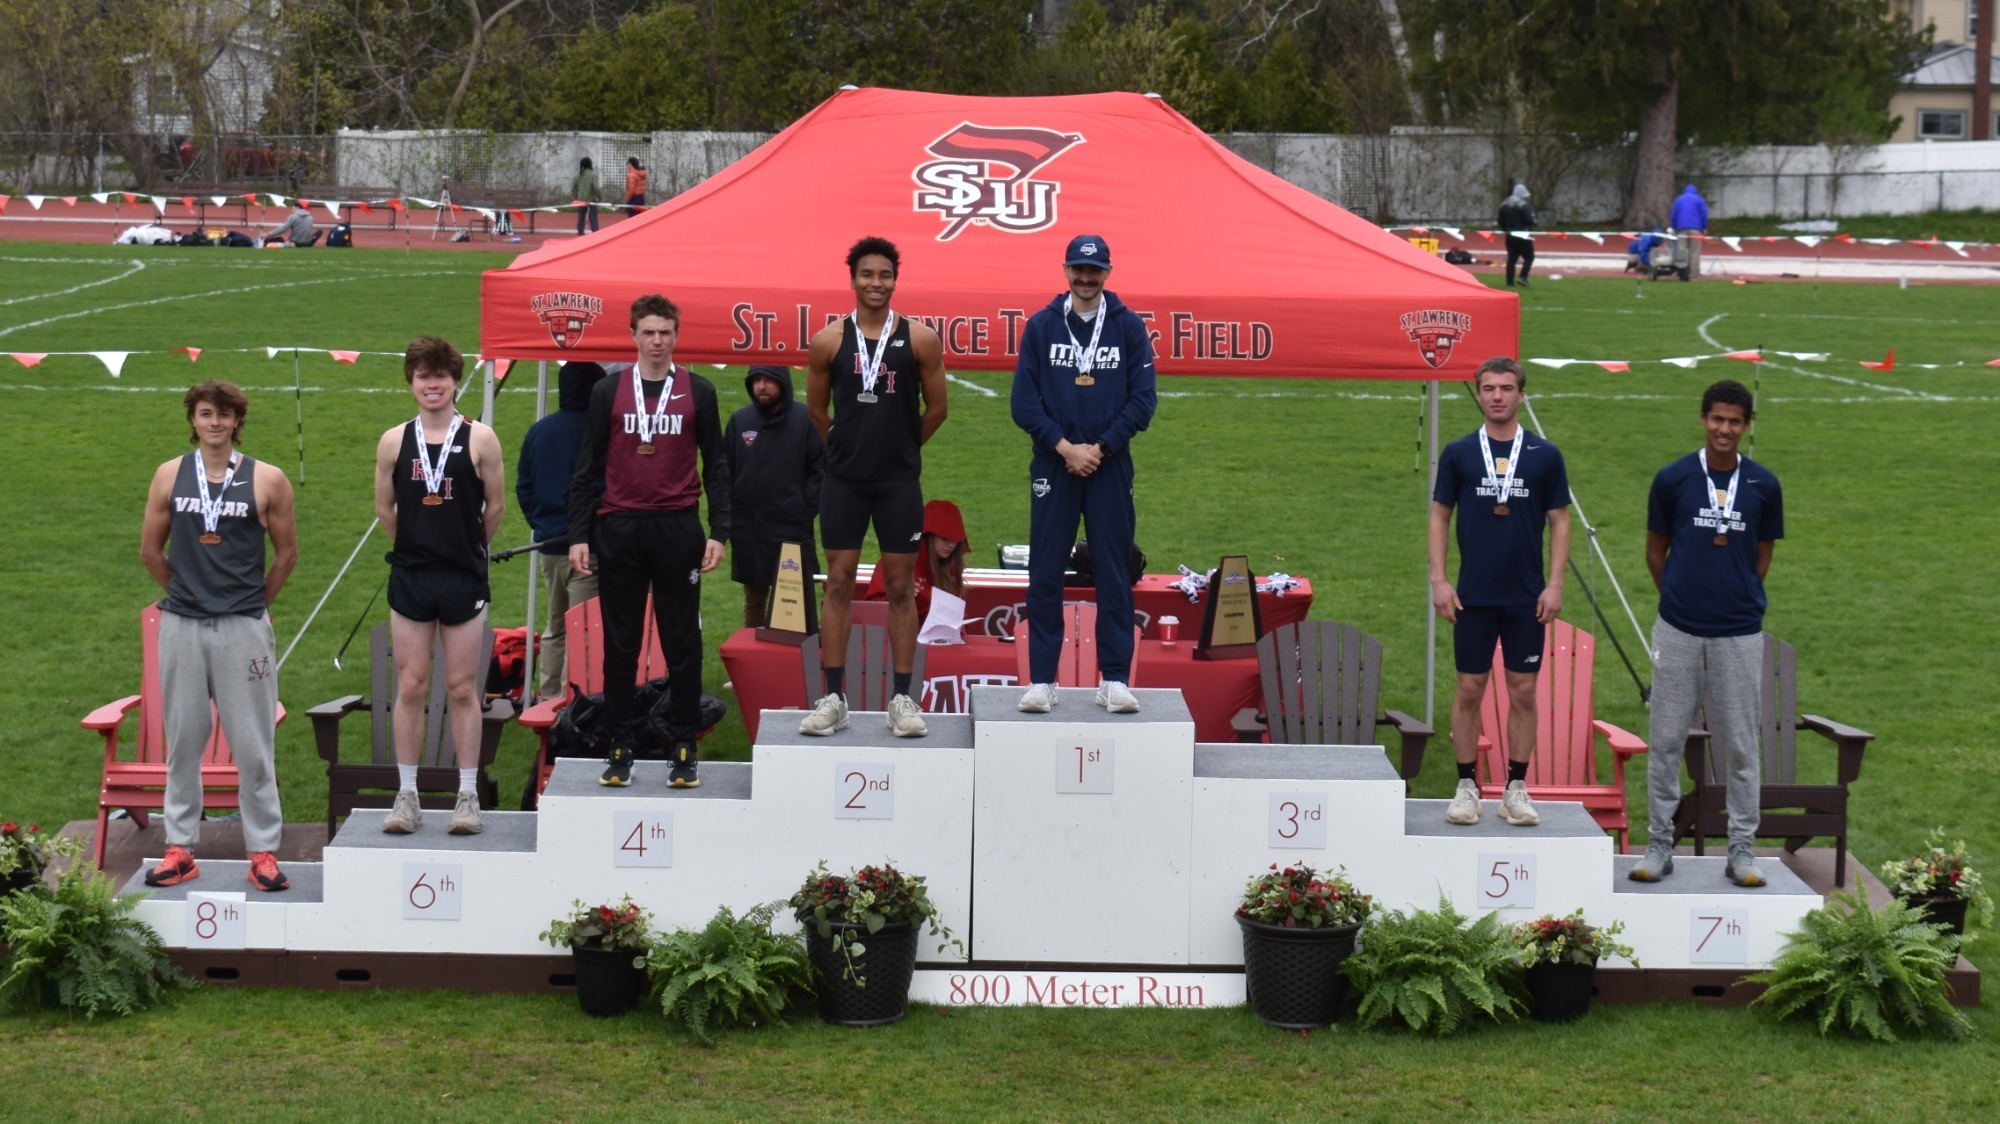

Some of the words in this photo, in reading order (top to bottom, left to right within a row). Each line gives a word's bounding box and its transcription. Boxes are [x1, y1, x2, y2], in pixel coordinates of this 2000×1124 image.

[531, 294, 546, 312] ST.
[546, 292, 602, 315] LAWRENCE
[1400, 311, 1415, 330] ST.
[1415, 310, 1472, 331] LAWRENCE
[797, 304, 990, 355] LNCE
[1170, 312, 1274, 361] FIELD
[1049, 344, 1121, 362] ITCA
[1051, 360, 1080, 368] TRAC
[1091, 361, 1119, 369] IELD
[624, 414, 684, 435] UION
[411, 459, 453, 500] RI
[175, 497, 249, 517] VAAR
[1074, 746, 1101, 783] 1st
[844, 771, 890, 809] 2nd
[1278, 801, 1321, 839] 3rd
[620, 820, 666, 857] 4th
[409, 873, 455, 909] 6th
[1485, 861, 1529, 898] 5th
[196, 901, 239, 939] 8th
[1695, 916, 1741, 952] 7th
[949, 974, 1011, 1005] 800
[1023, 975, 1125, 1005] Meter
[1135, 976, 1205, 1006] Run
